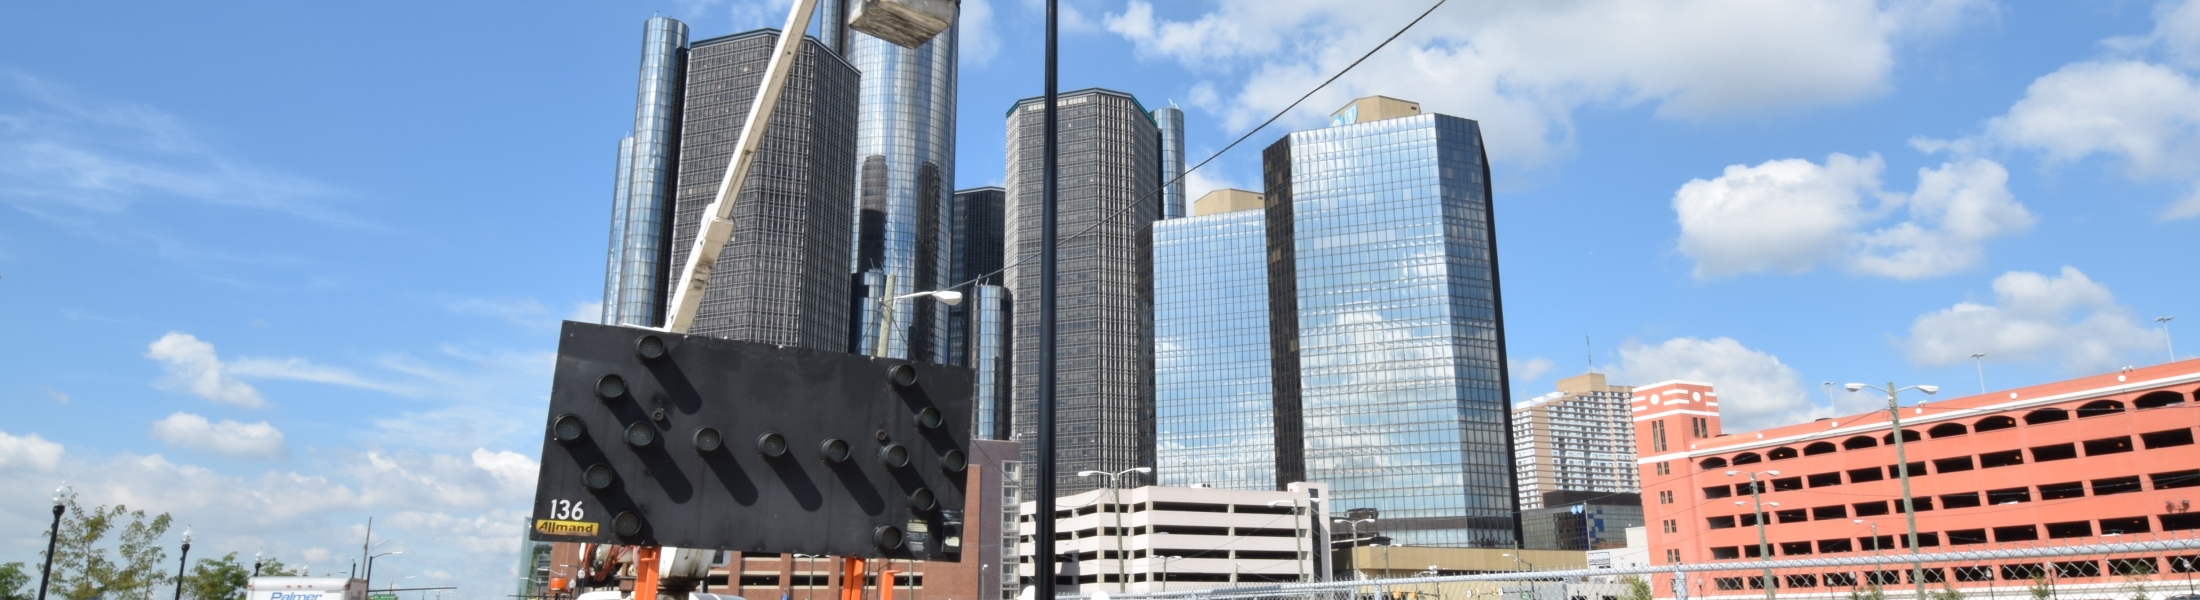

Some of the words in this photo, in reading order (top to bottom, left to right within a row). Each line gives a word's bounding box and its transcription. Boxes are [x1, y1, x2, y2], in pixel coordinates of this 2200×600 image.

[550, 499, 584, 521] 136
[538, 521, 594, 533] Allmand
[270, 592, 323, 600] Palmer
